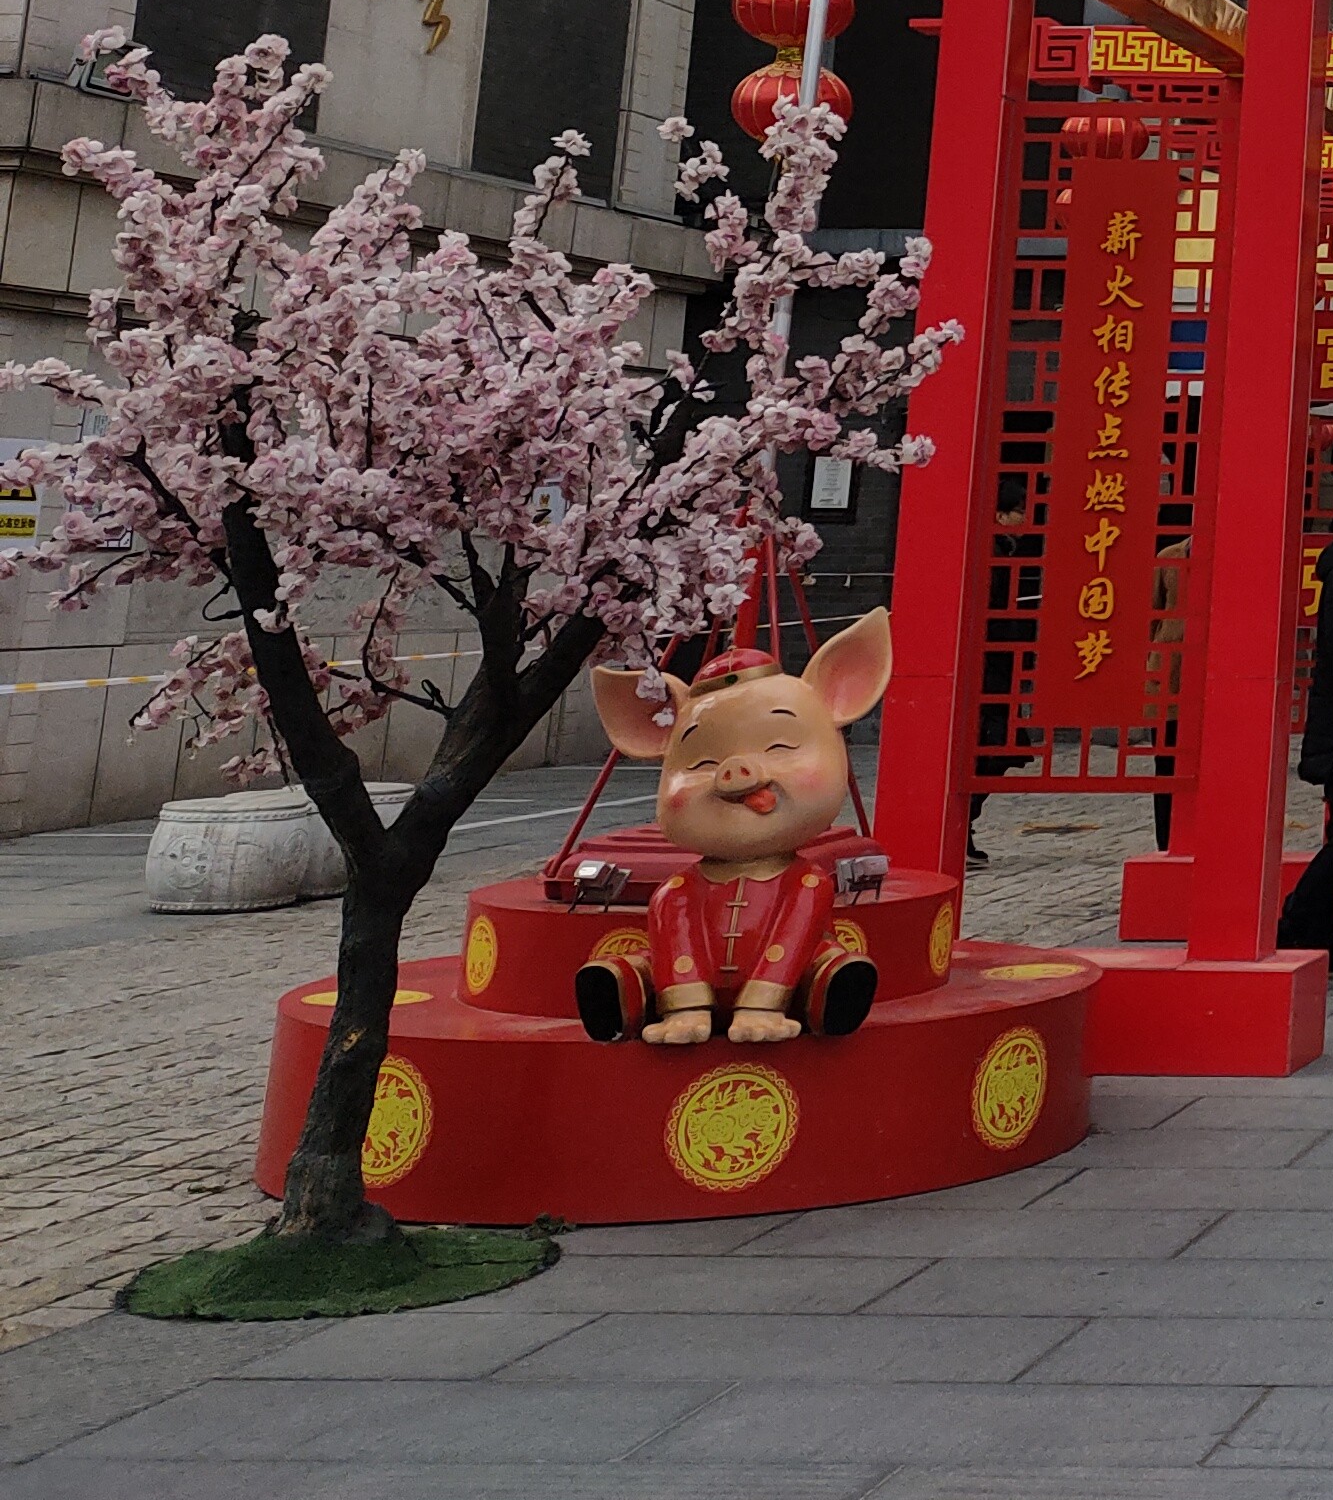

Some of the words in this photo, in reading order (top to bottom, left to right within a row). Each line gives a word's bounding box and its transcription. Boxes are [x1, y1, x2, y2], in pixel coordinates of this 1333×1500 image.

[1074, 210, 1143, 680] 薪火相传点燃中国梦
